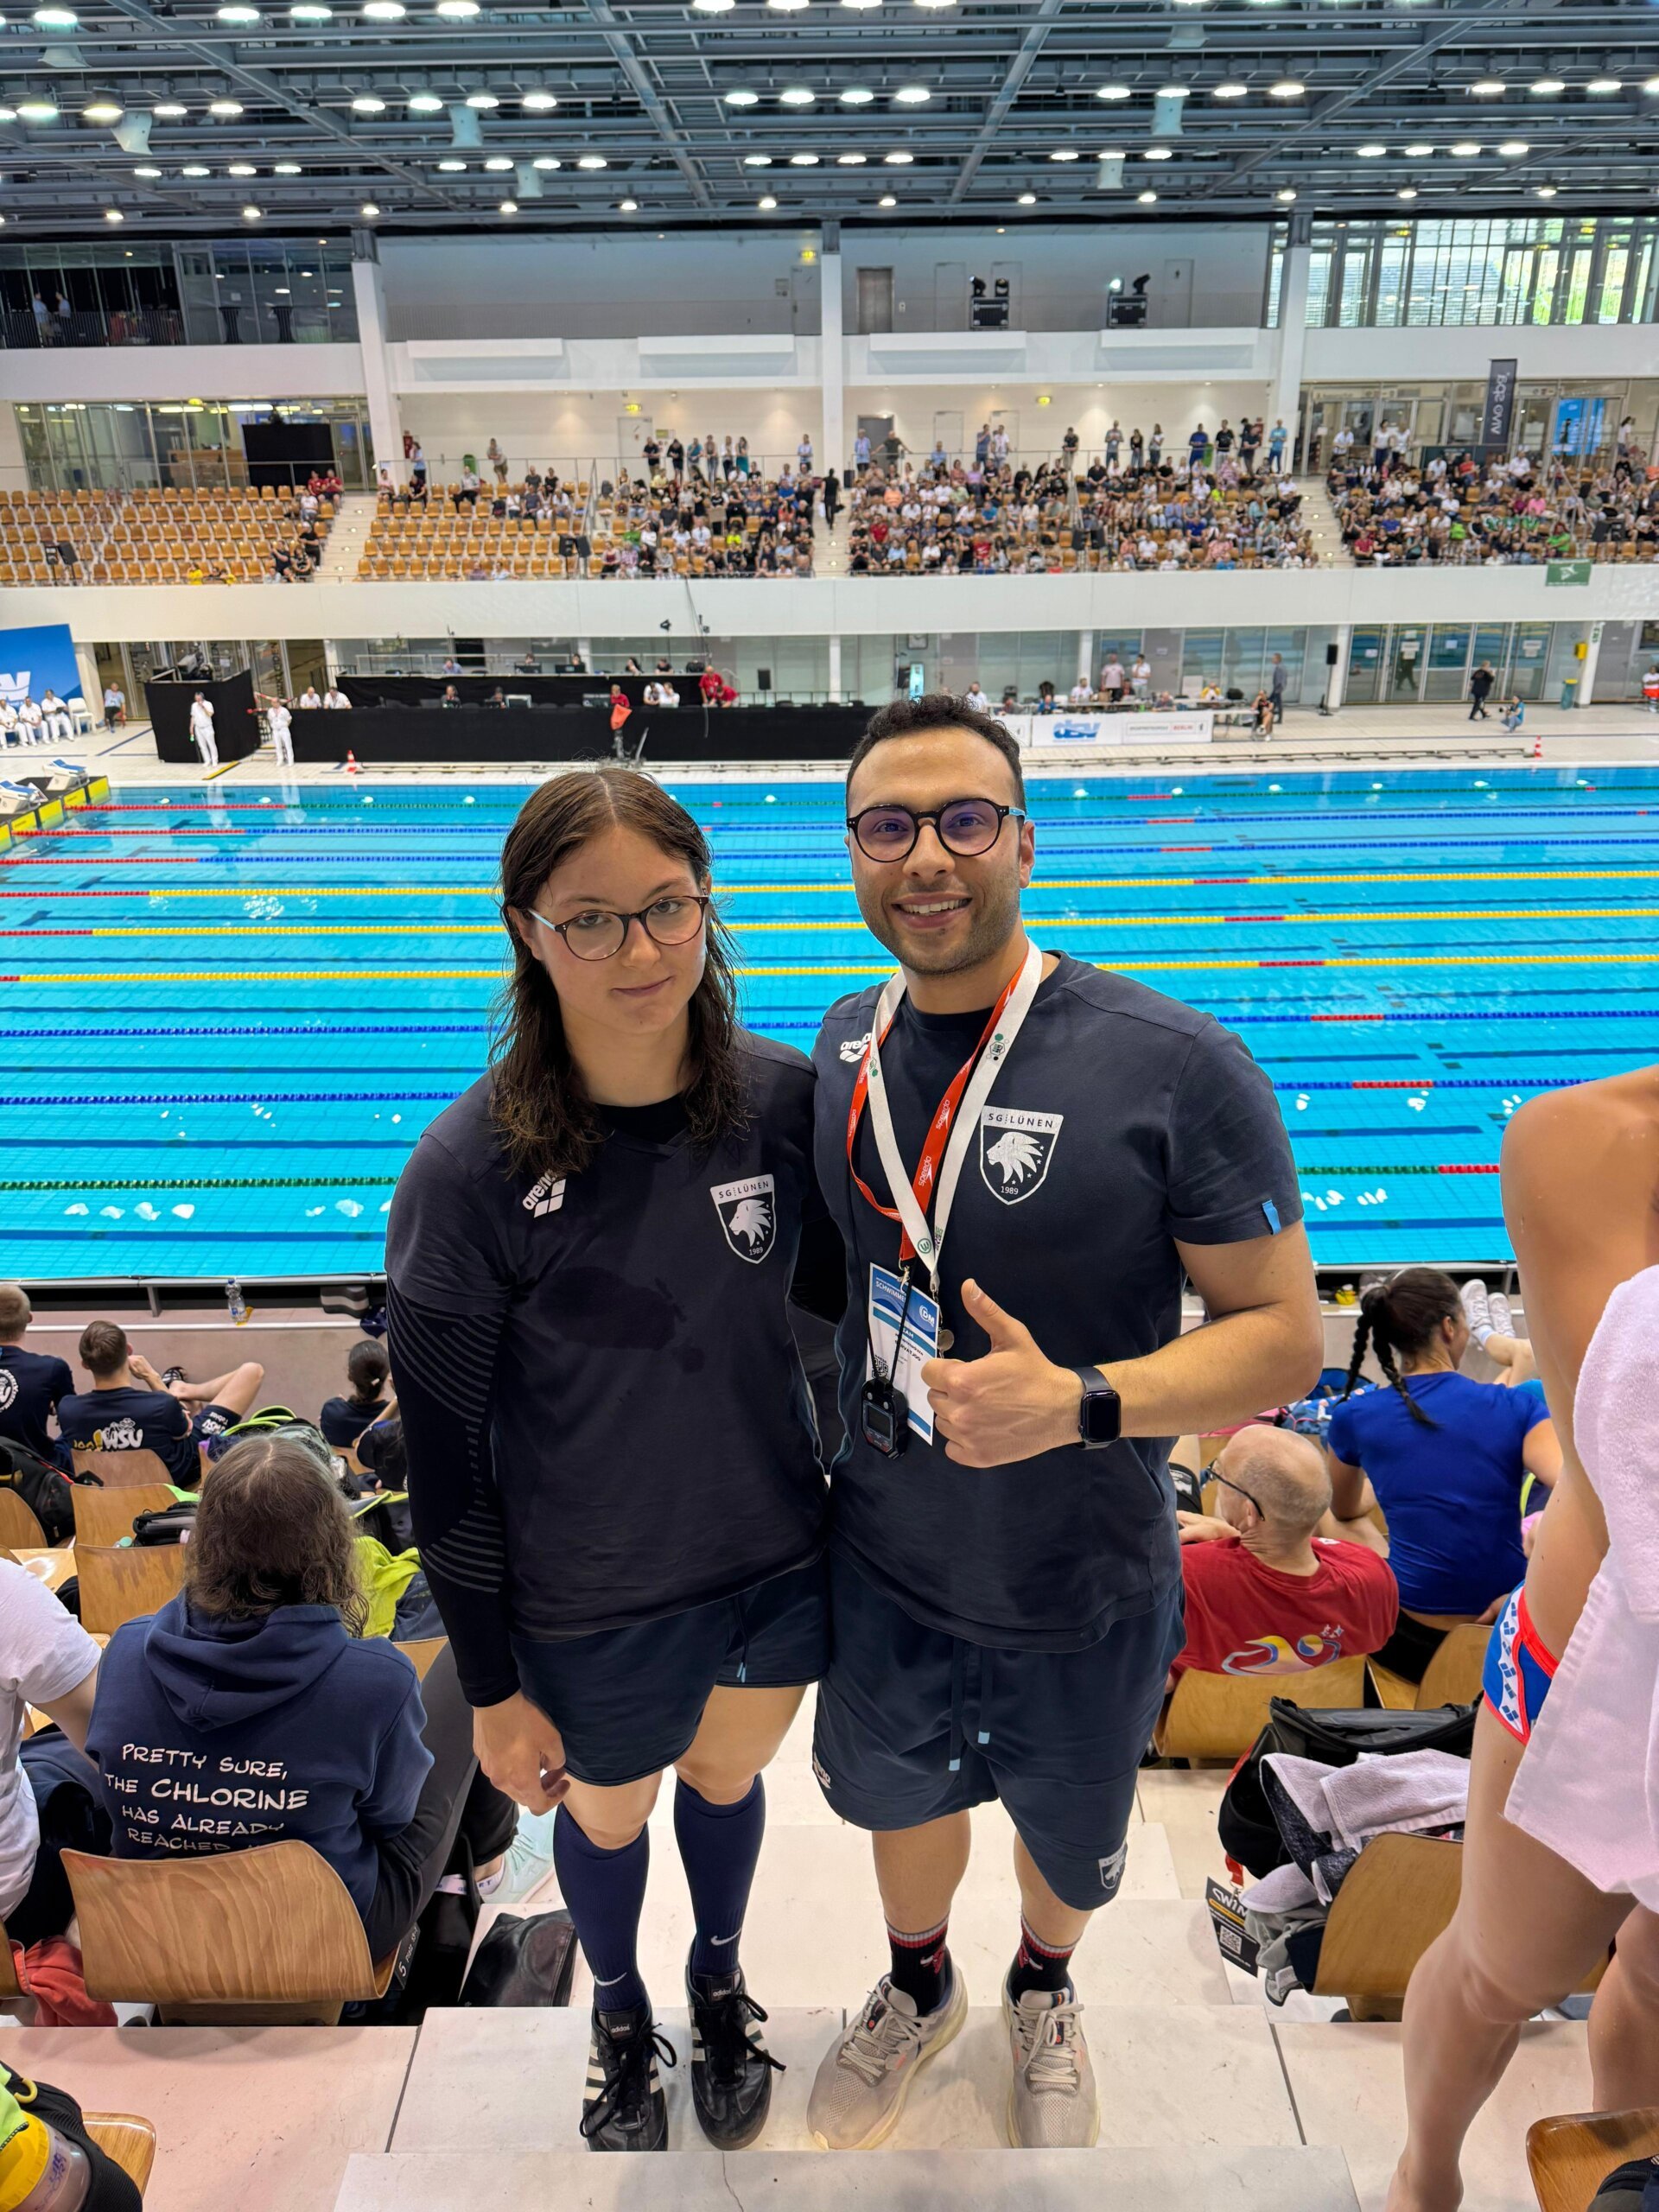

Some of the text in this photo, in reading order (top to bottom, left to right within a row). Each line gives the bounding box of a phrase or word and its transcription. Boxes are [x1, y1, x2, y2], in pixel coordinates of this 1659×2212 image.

[936, 1099, 950, 1130] speedo
[988, 1113, 1053, 1128] SG LÜNEN
[918, 1155, 932, 1186] speedo
[718, 1180, 769, 1199] SG LÜNEN
[1001, 1185, 1019, 1195] 1989
[748, 1246, 764, 1256] 1989
[875, 1280, 906, 1302] SCHWIMME
[122, 1743, 288, 1781] PRETTY SURE,
[105, 1773, 309, 1810] THE CHLORINE
[122, 1805, 284, 1837] HAS ALREADY
[127, 1827, 232, 1851] REACHED
